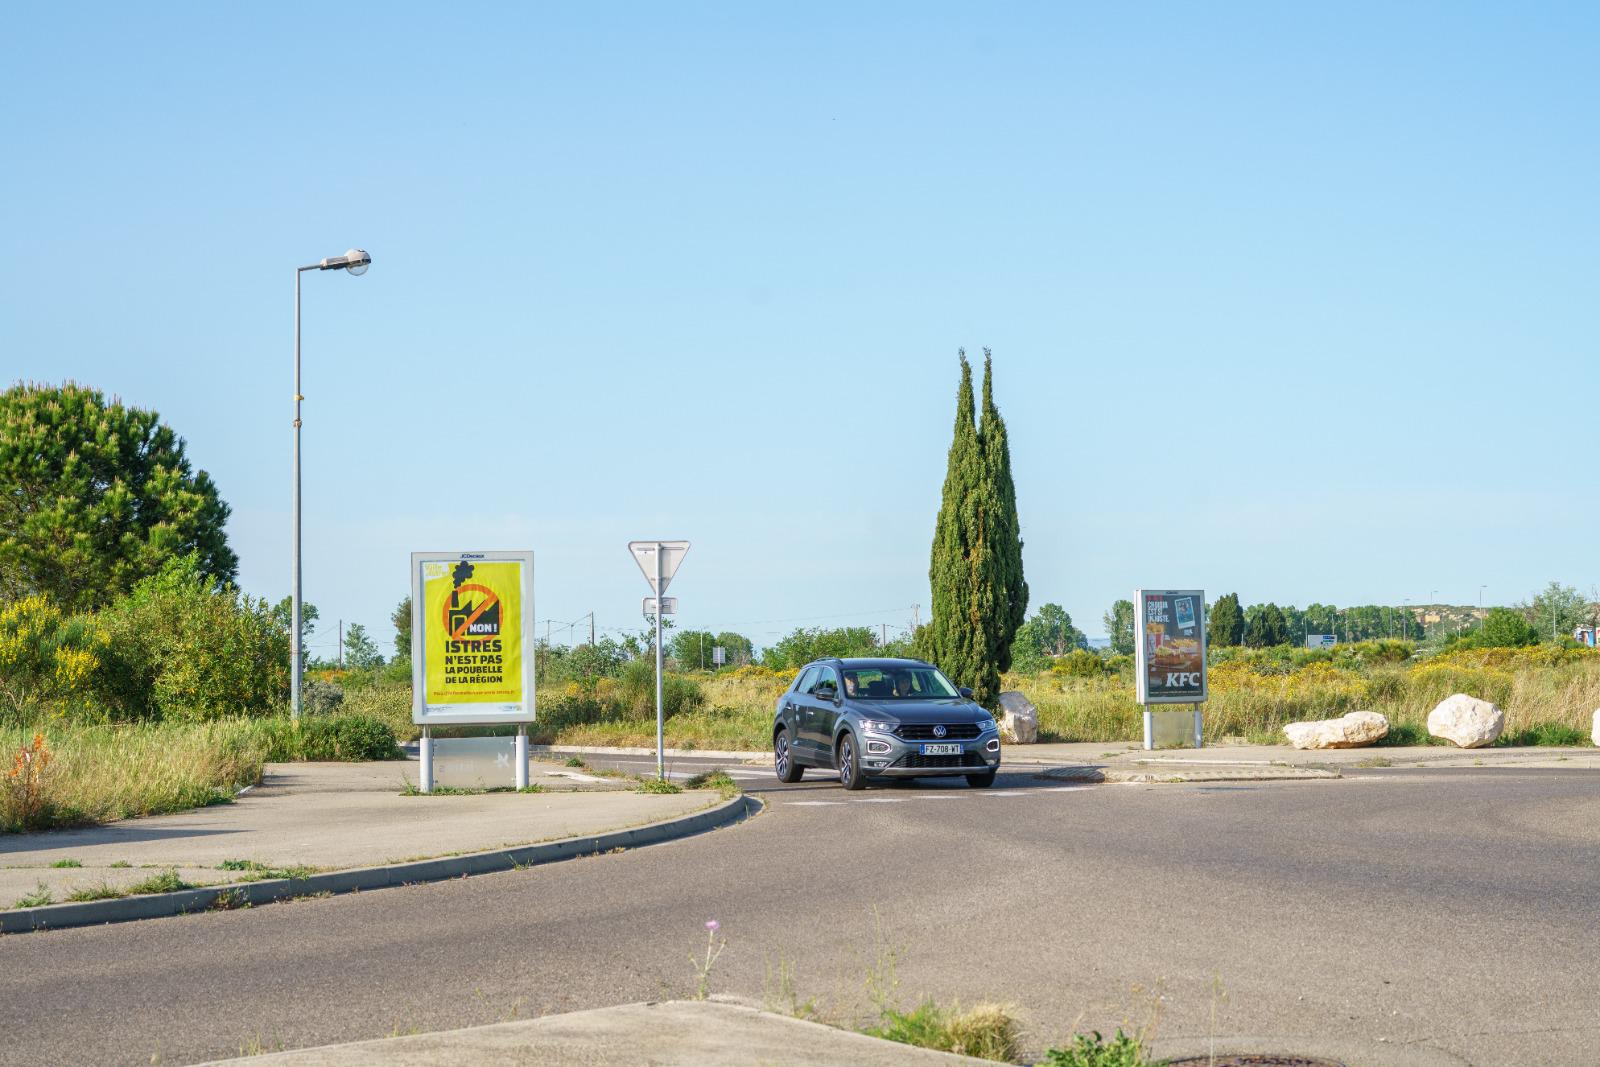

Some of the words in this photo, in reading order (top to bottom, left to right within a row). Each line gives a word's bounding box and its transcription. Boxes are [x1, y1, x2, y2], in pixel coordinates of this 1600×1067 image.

[445, 639, 503, 653] ISTRES
[445, 655, 478, 665] N'EST
[480, 654, 503, 664] PAS
[445, 666, 455, 674] LA
[457, 665, 503, 674] POUBELLE
[445, 676, 457, 684] DE
[458, 676, 469, 684] LA
[469, 674, 503, 684] RÉGION
[1165, 672, 1200, 687] KFC
